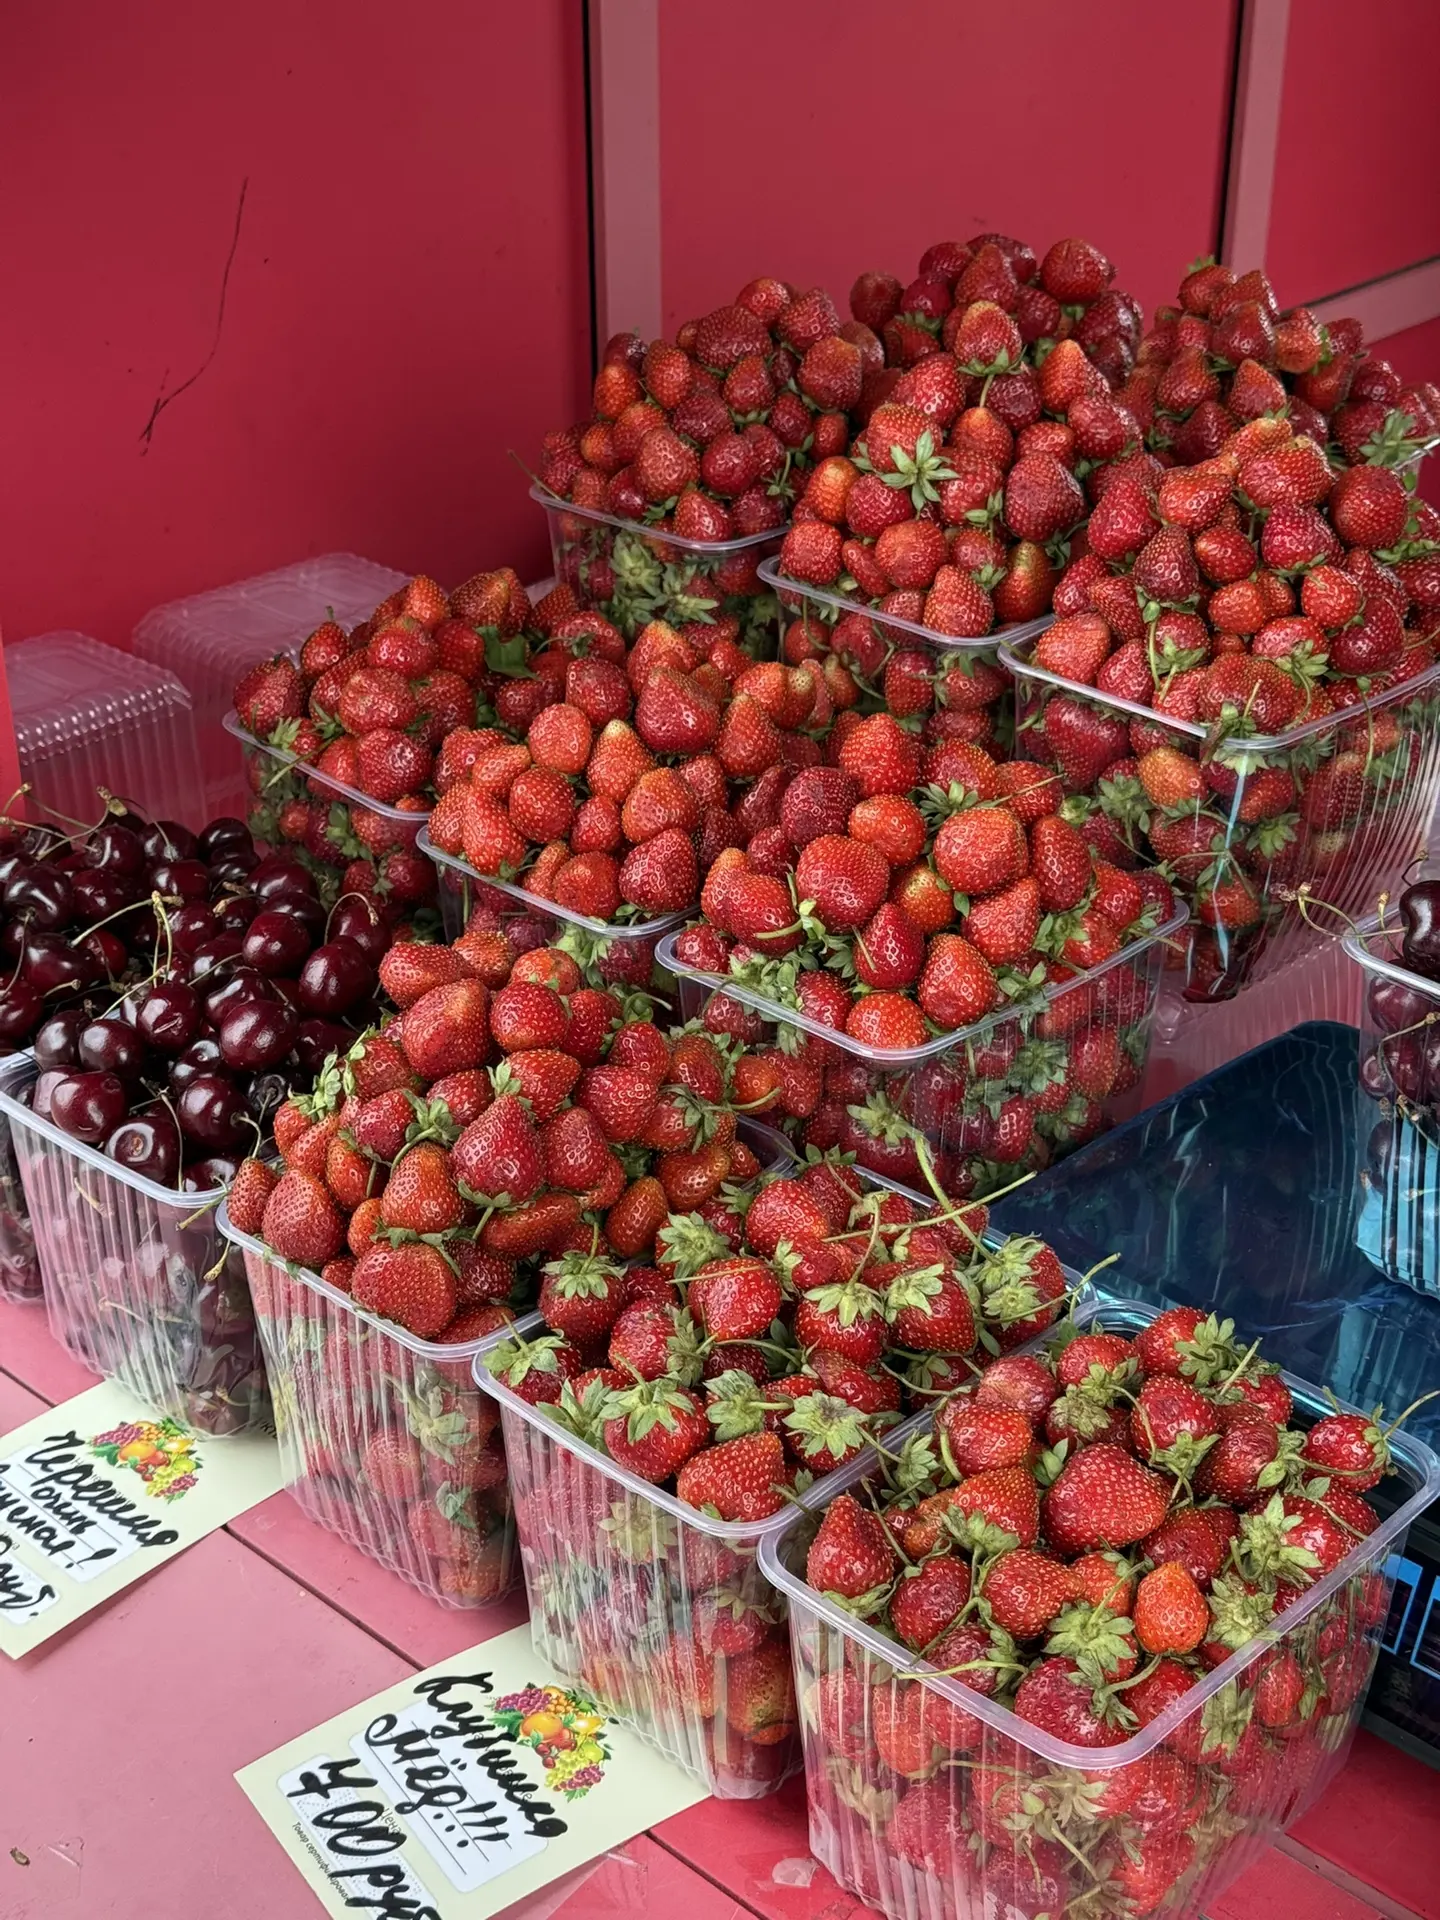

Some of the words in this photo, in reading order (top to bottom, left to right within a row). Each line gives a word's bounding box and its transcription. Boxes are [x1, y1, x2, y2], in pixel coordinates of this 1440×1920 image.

[24, 1429, 179, 1548] Черешня
[30, 1486, 98, 1535] очень
[413, 1671, 568, 1838] Клубника
[286, 1757, 408, 1857] 700
[292, 1821, 310, 1843] Товар
